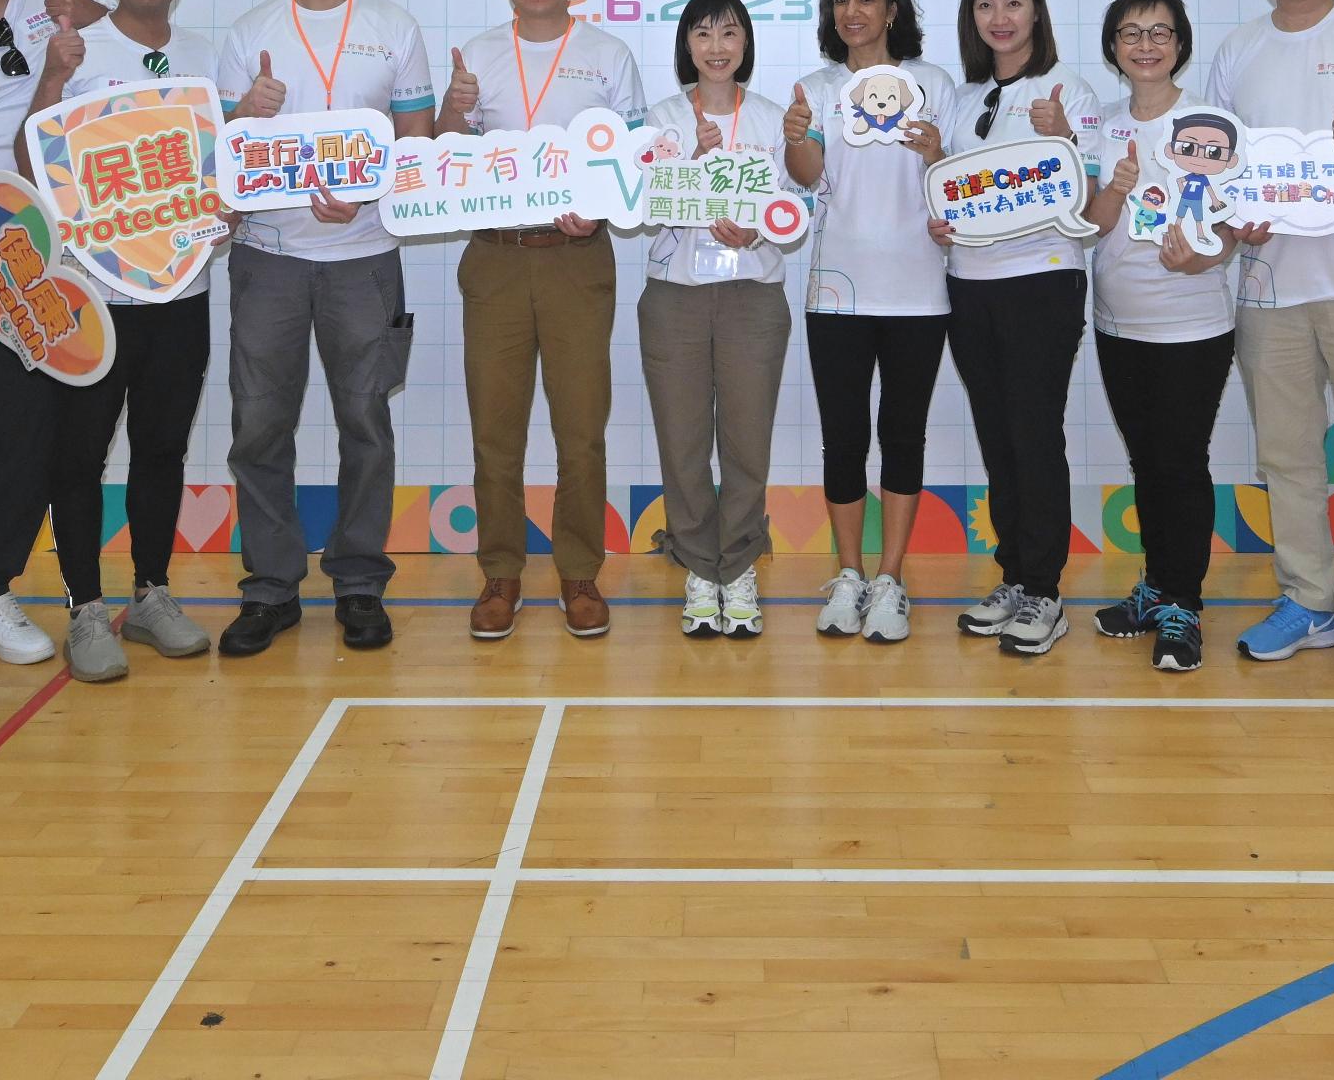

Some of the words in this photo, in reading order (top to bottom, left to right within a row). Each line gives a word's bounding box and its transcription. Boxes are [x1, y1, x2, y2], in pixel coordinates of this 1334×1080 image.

[82, 131, 198, 206] 保護
[393, 141, 569, 194] 童行有你
[649, 155, 774, 195] 凝聚家庭
[392, 199, 449, 219] WALK
[461, 194, 513, 213] WITH
[526, 188, 573, 208] KIDS
[649, 197, 757, 223] 齊抗暴力
